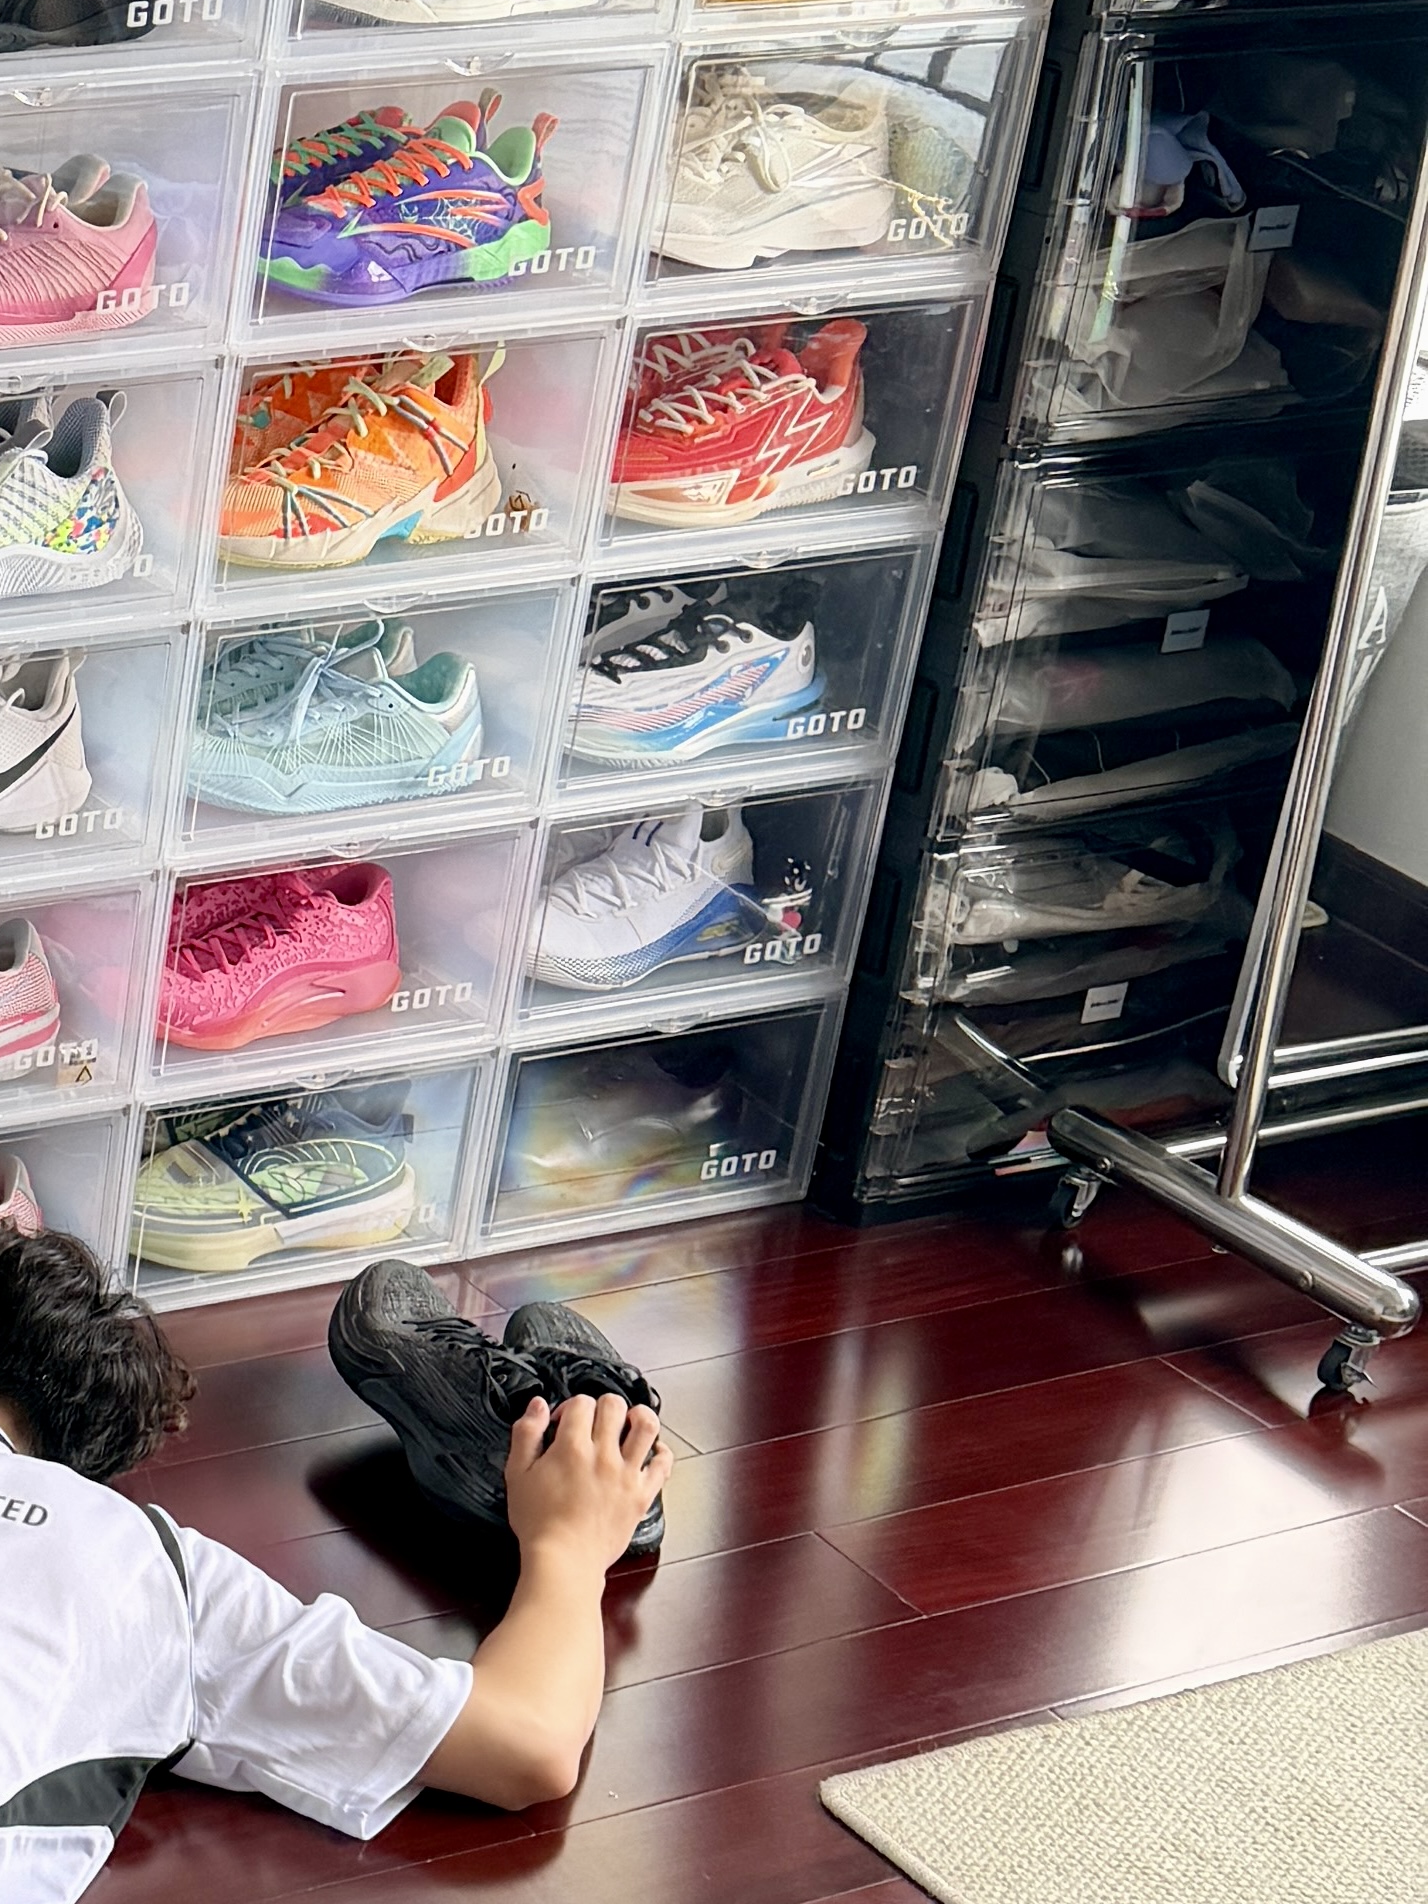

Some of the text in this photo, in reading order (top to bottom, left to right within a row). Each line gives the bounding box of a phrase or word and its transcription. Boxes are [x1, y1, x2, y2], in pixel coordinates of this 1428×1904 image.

[888, 213, 967, 242] GOTO
[508, 247, 595, 275] GOTO
[96, 283, 188, 315] GOTO
[839, 465, 916, 495] GOTO
[464, 509, 548, 538] GOTO
[787, 710, 865, 739] GOTO
[427, 757, 510, 787] GOTO
[34, 807, 123, 840] GOTO
[744, 934, 821, 964] GOTO
[391, 983, 473, 1012] GOTO
[701, 1148, 777, 1180] GOTO
